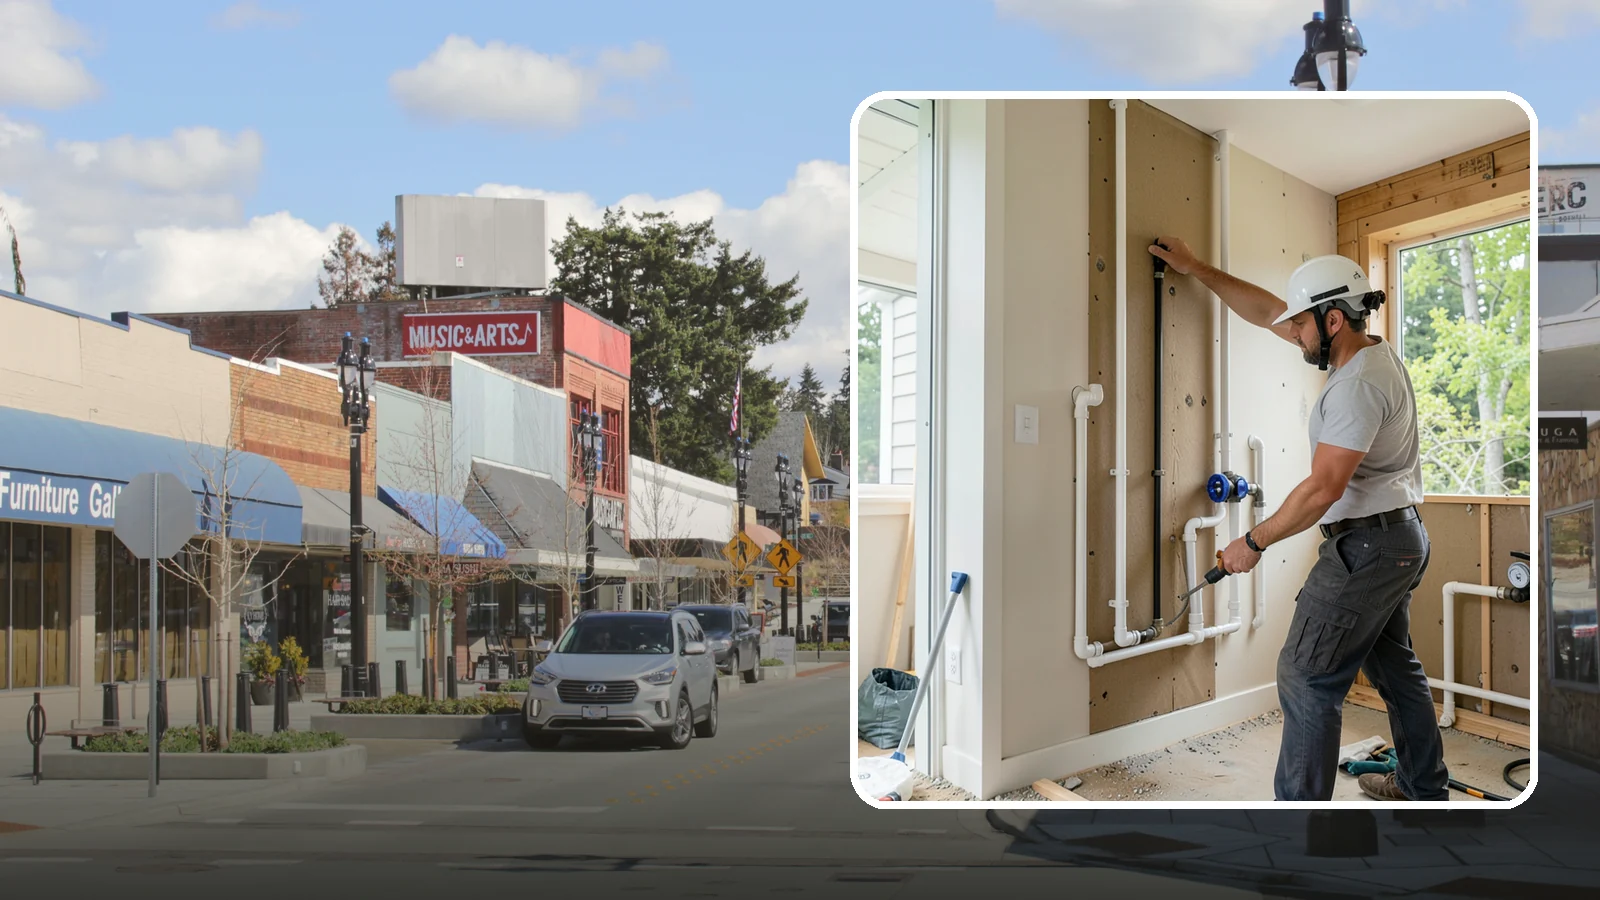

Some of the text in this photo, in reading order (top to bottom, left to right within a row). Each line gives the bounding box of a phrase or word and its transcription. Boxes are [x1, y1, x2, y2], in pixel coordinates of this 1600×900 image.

[408, 322, 520, 349] MUSIC&ARTS
[0, 471, 122, 519] Furniture Gal
